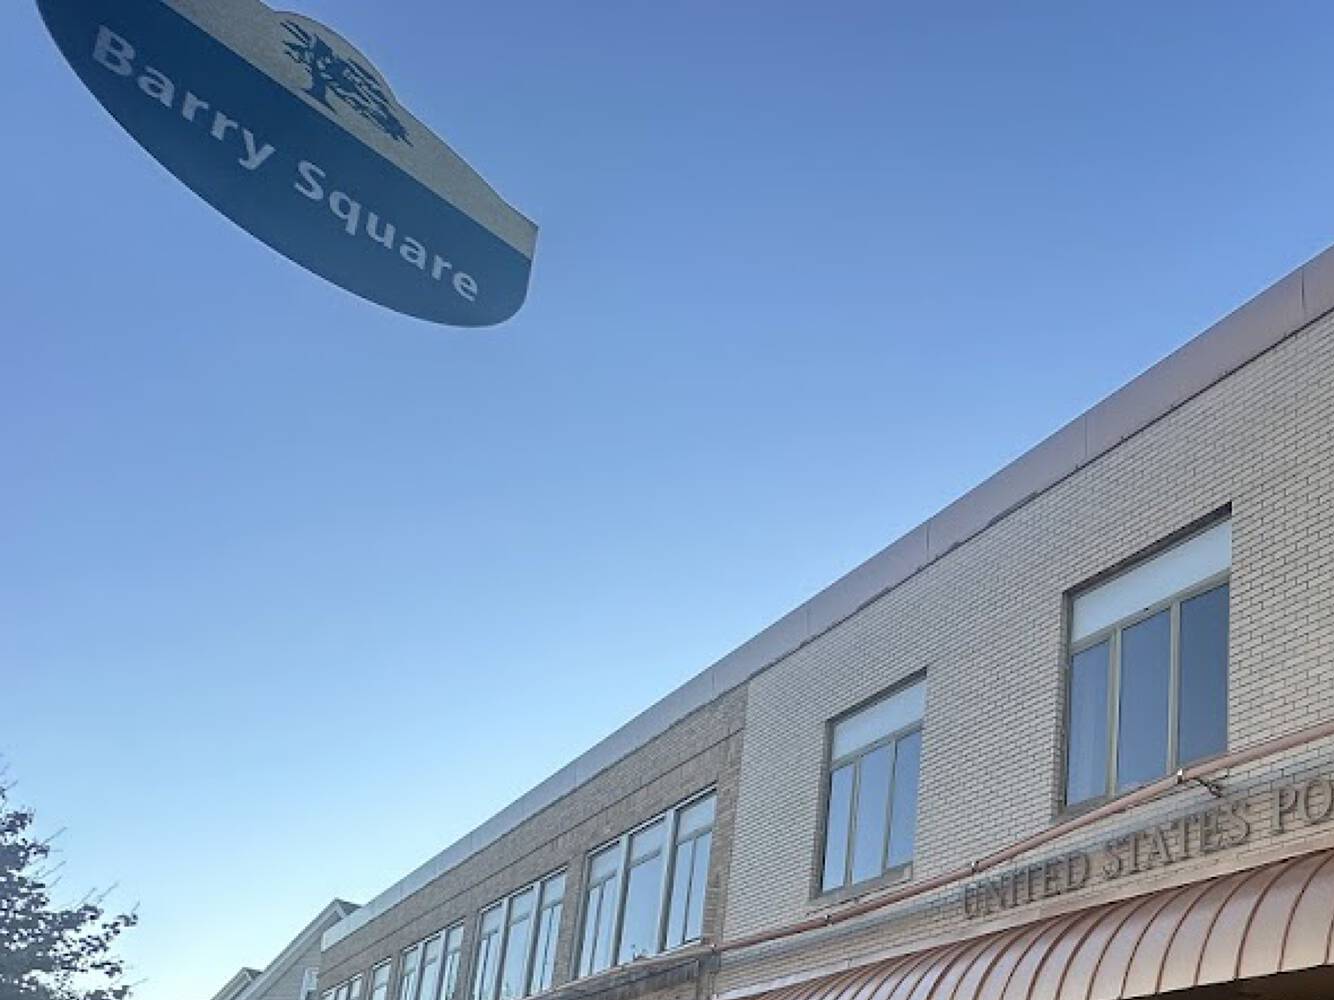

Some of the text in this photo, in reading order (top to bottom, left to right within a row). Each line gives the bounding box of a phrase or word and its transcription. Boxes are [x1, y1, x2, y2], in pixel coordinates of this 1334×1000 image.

[91, 24, 479, 302] Barry Square
[961, 852, 1091, 919] UNITED
[1102, 803, 1252, 881] STATES
